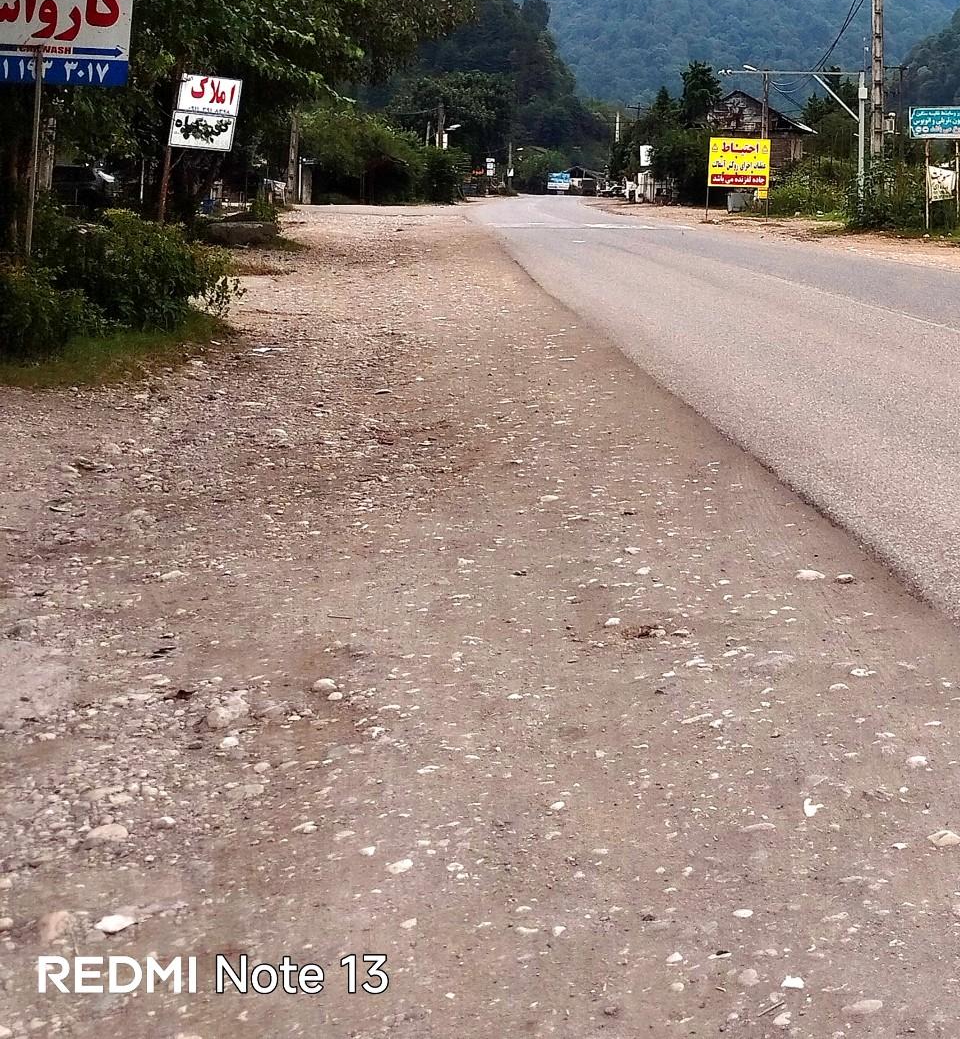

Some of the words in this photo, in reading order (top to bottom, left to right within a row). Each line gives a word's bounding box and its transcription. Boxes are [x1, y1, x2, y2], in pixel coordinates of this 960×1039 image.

[64, 61, 109, 83] ۳۰۱۷
[191, 77, 236, 105] املاک
[722, 142, 759, 156] احتیاط
